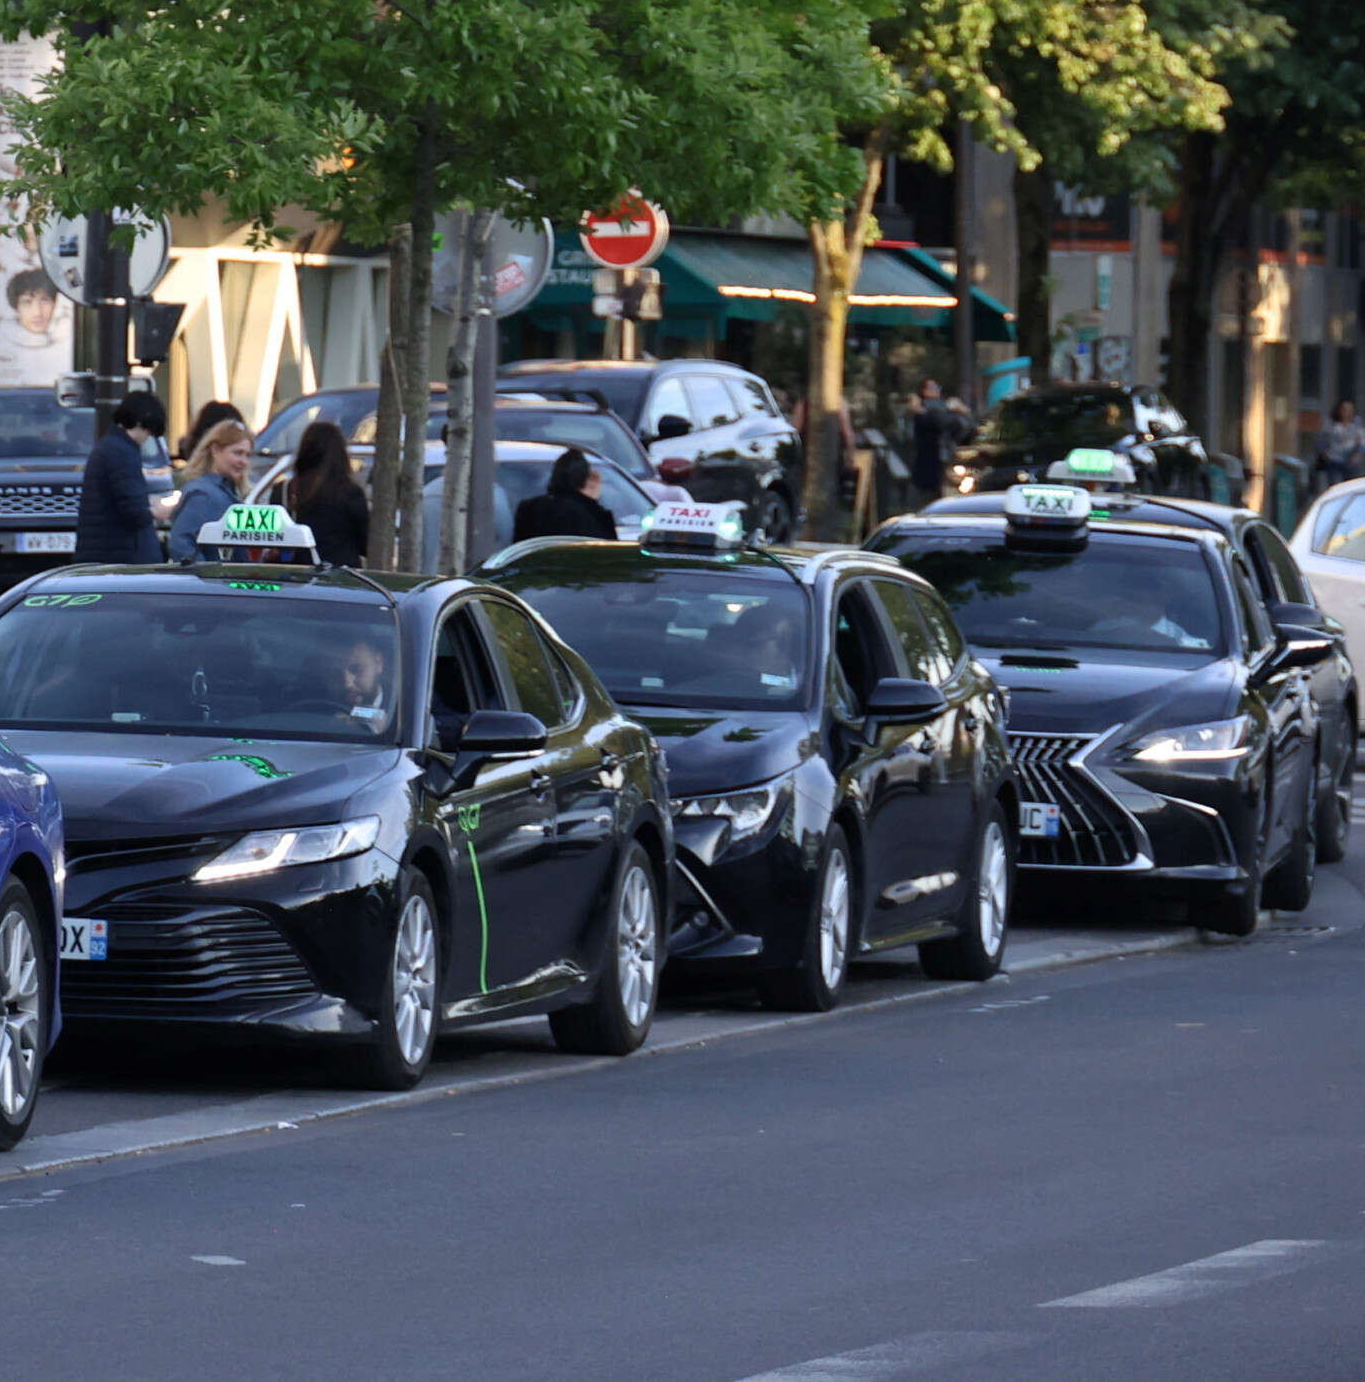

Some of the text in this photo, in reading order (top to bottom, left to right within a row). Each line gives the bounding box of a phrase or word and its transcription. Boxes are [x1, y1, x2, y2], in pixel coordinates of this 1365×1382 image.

[1025, 495, 1073, 510] TAXI
[669, 507, 712, 519] TAXI
[232, 509, 276, 531] TAXI
[659, 518, 716, 527] PARISIEN
[222, 530, 284, 542] PARISIEN
